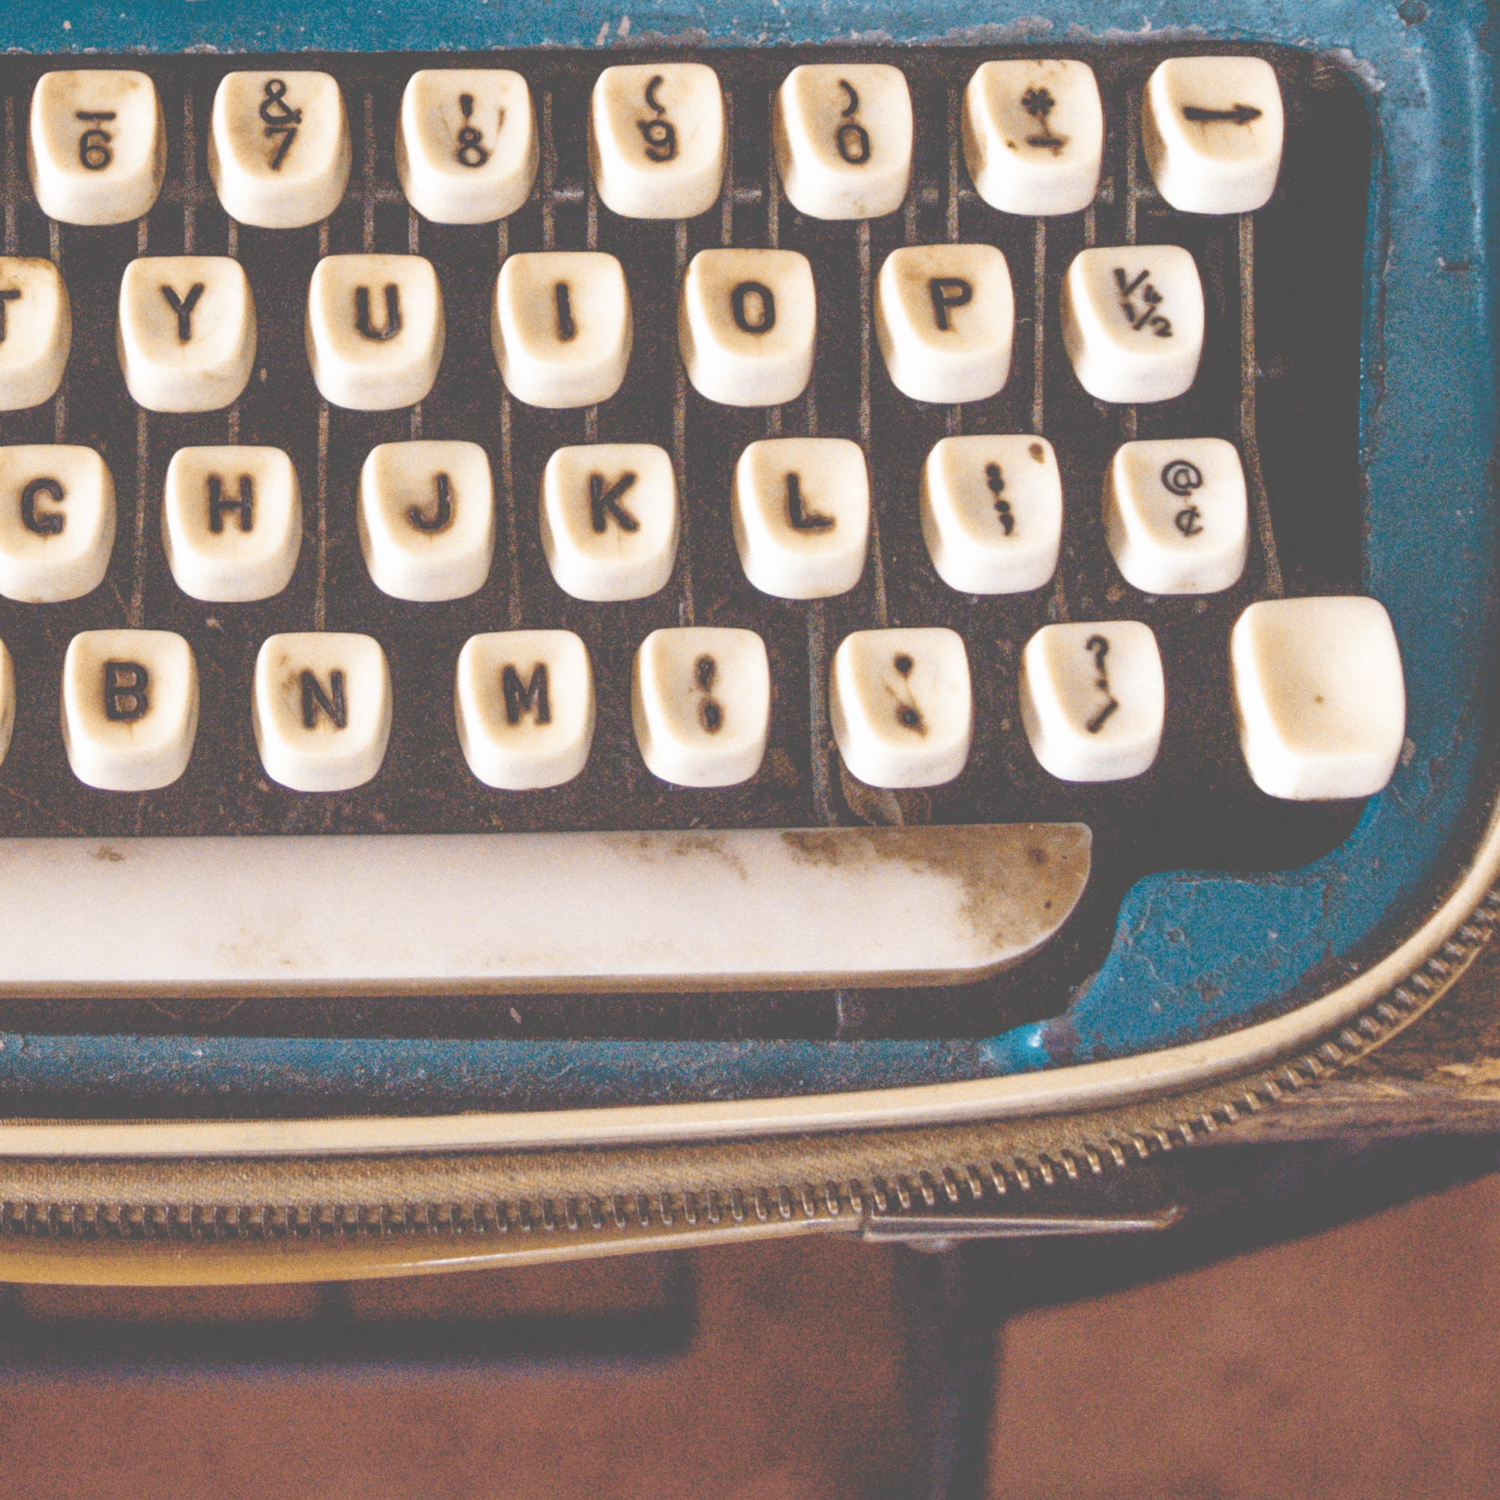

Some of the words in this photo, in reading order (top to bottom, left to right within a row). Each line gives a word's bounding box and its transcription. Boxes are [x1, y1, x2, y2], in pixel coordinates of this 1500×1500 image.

[258, 78, 302, 126] &
[78, 128, 112, 172] 6
[259, 126, 299, 171] 7
[456, 126, 489, 169] 8
[636, 119, 679, 164] 9
[835, 124, 871, 165] 0
[160, 282, 206, 344] Y
[353, 282, 403, 342] U
[554, 281, 578, 343] I
[730, 281, 777, 334] O
[929, 275, 974, 332] P
[19, 476, 65, 536] G
[206, 473, 255, 536] H
[408, 472, 452, 532] J
[587, 469, 642, 535] K
[782, 471, 836, 534] L
[1159, 459, 1205, 499] @
[1086, 634, 1109, 691] ?
[102, 660, 150, 722] B
[299, 669, 349, 730] N
[501, 662, 552, 726] M
